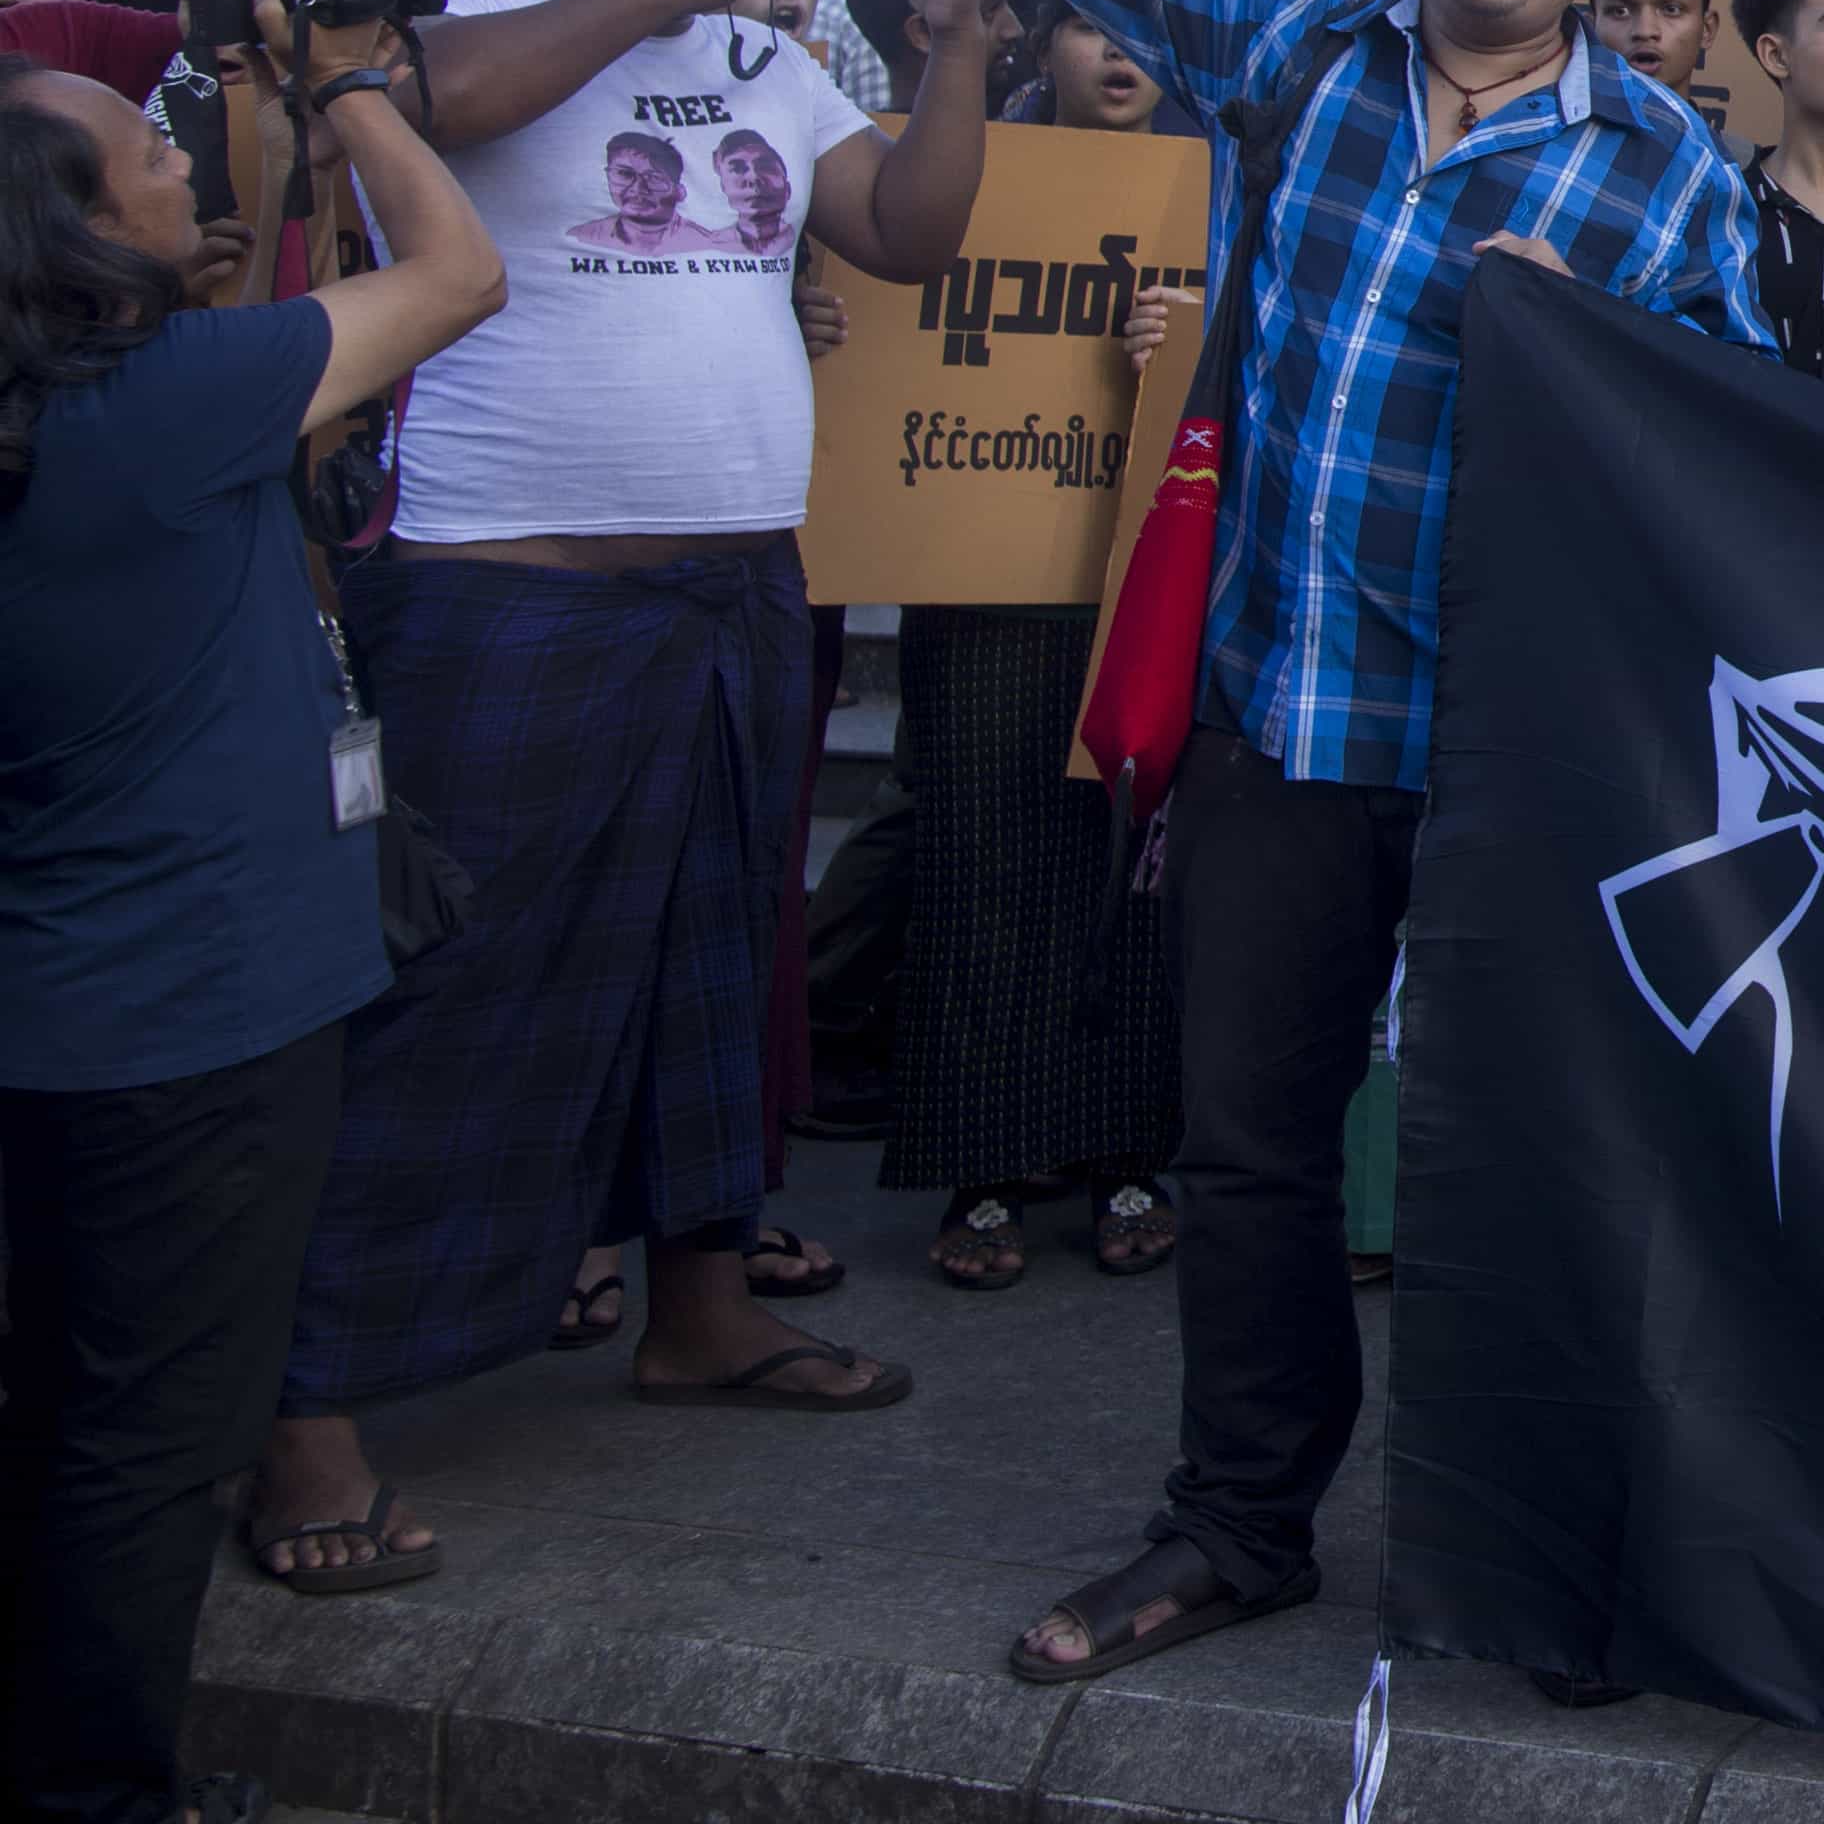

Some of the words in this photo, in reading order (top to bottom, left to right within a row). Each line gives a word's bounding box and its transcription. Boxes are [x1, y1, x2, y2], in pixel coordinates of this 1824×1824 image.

[570, 256, 610, 275] WA
[617, 259, 679, 275] LONE
[687, 258, 700, 274] &
[705, 258, 758, 274] KYAW
